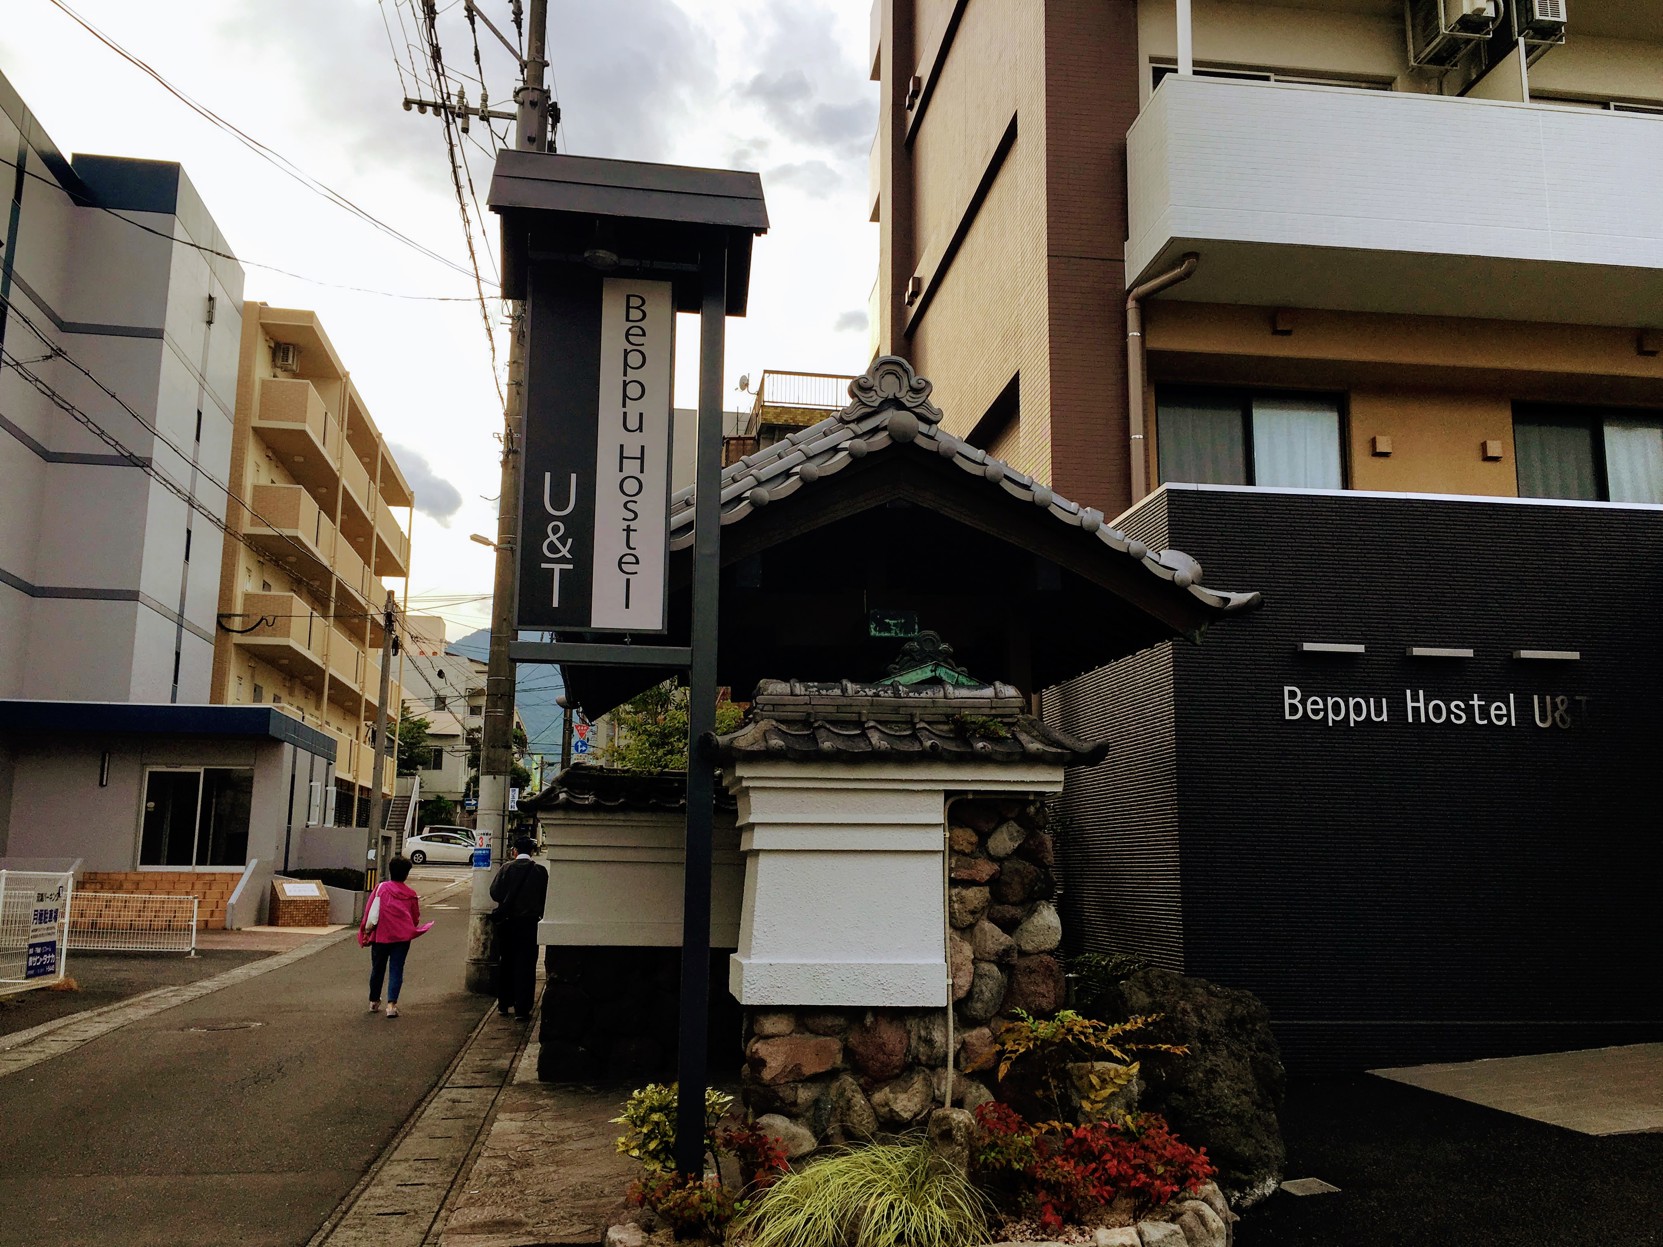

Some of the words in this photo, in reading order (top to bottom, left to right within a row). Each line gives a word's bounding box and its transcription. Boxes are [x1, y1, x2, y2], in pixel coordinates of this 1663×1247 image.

[621, 293, 647, 434] Beppu
[540, 471, 577, 608] U&T
[617, 443, 645, 610] Hostel
[1283, 685, 1388, 727] Beppu
[1405, 689, 1516, 727] Hostel
